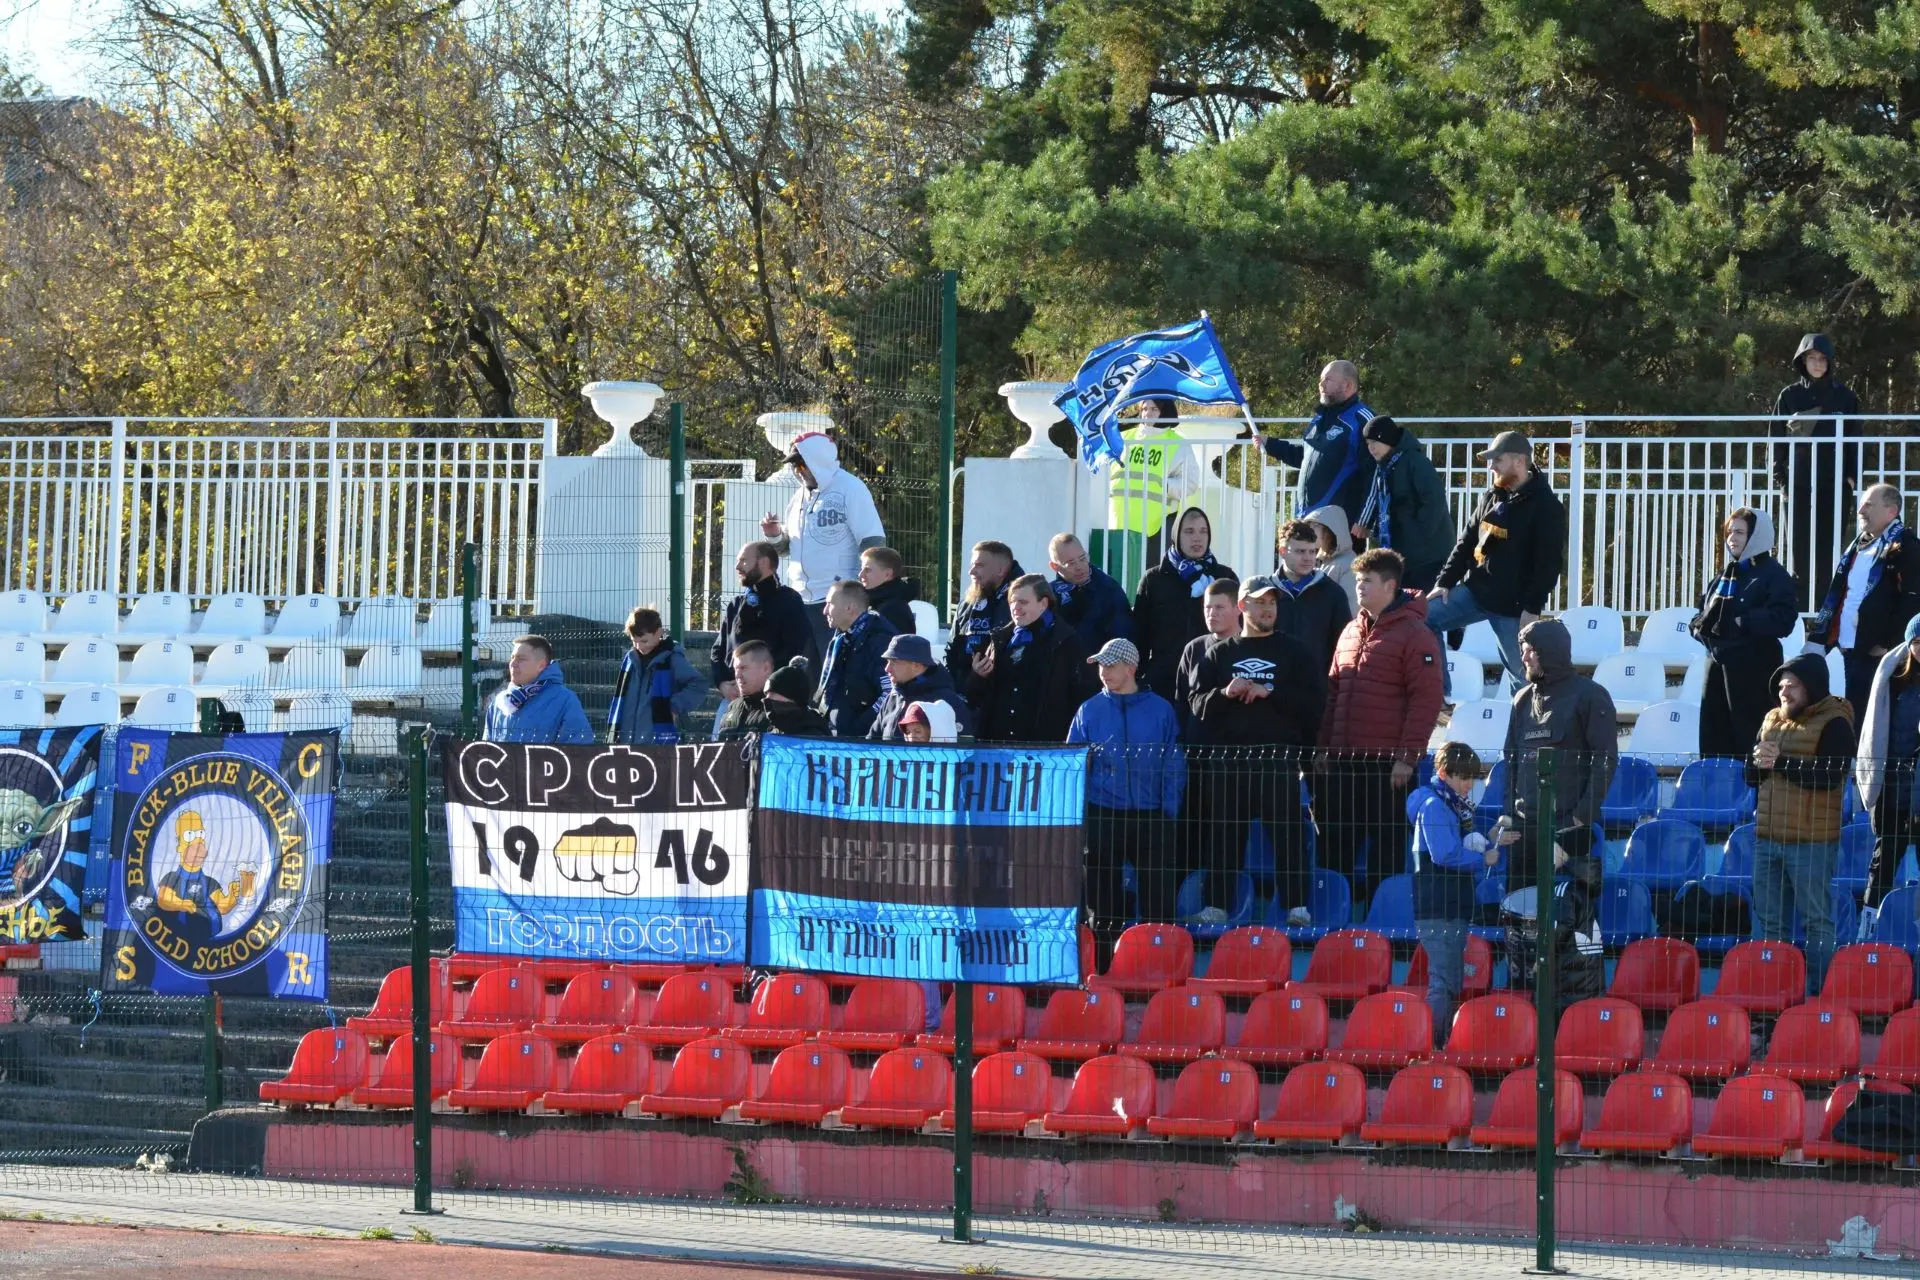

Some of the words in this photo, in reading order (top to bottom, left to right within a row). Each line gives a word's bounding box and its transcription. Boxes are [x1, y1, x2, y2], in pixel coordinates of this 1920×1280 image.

[127, 741, 151, 775] F
[297, 743, 323, 778] C
[459, 740, 728, 808] СРФК
[128, 762, 241, 887] BLACK-BLUE
[247, 770, 303, 891] VILLAGE
[472, 821, 540, 883] 19
[654, 827, 731, 886] 46
[145, 916, 190, 962] OLD
[192, 918, 282, 972] SCHOOL
[487, 907, 732, 956] ГОРДОСТЬ
[799, 915, 896, 962] ОТДЫХ
[931, 927, 1029, 968] ТАНЦЫ
[115, 946, 137, 982] S
[284, 952, 312, 986] R
